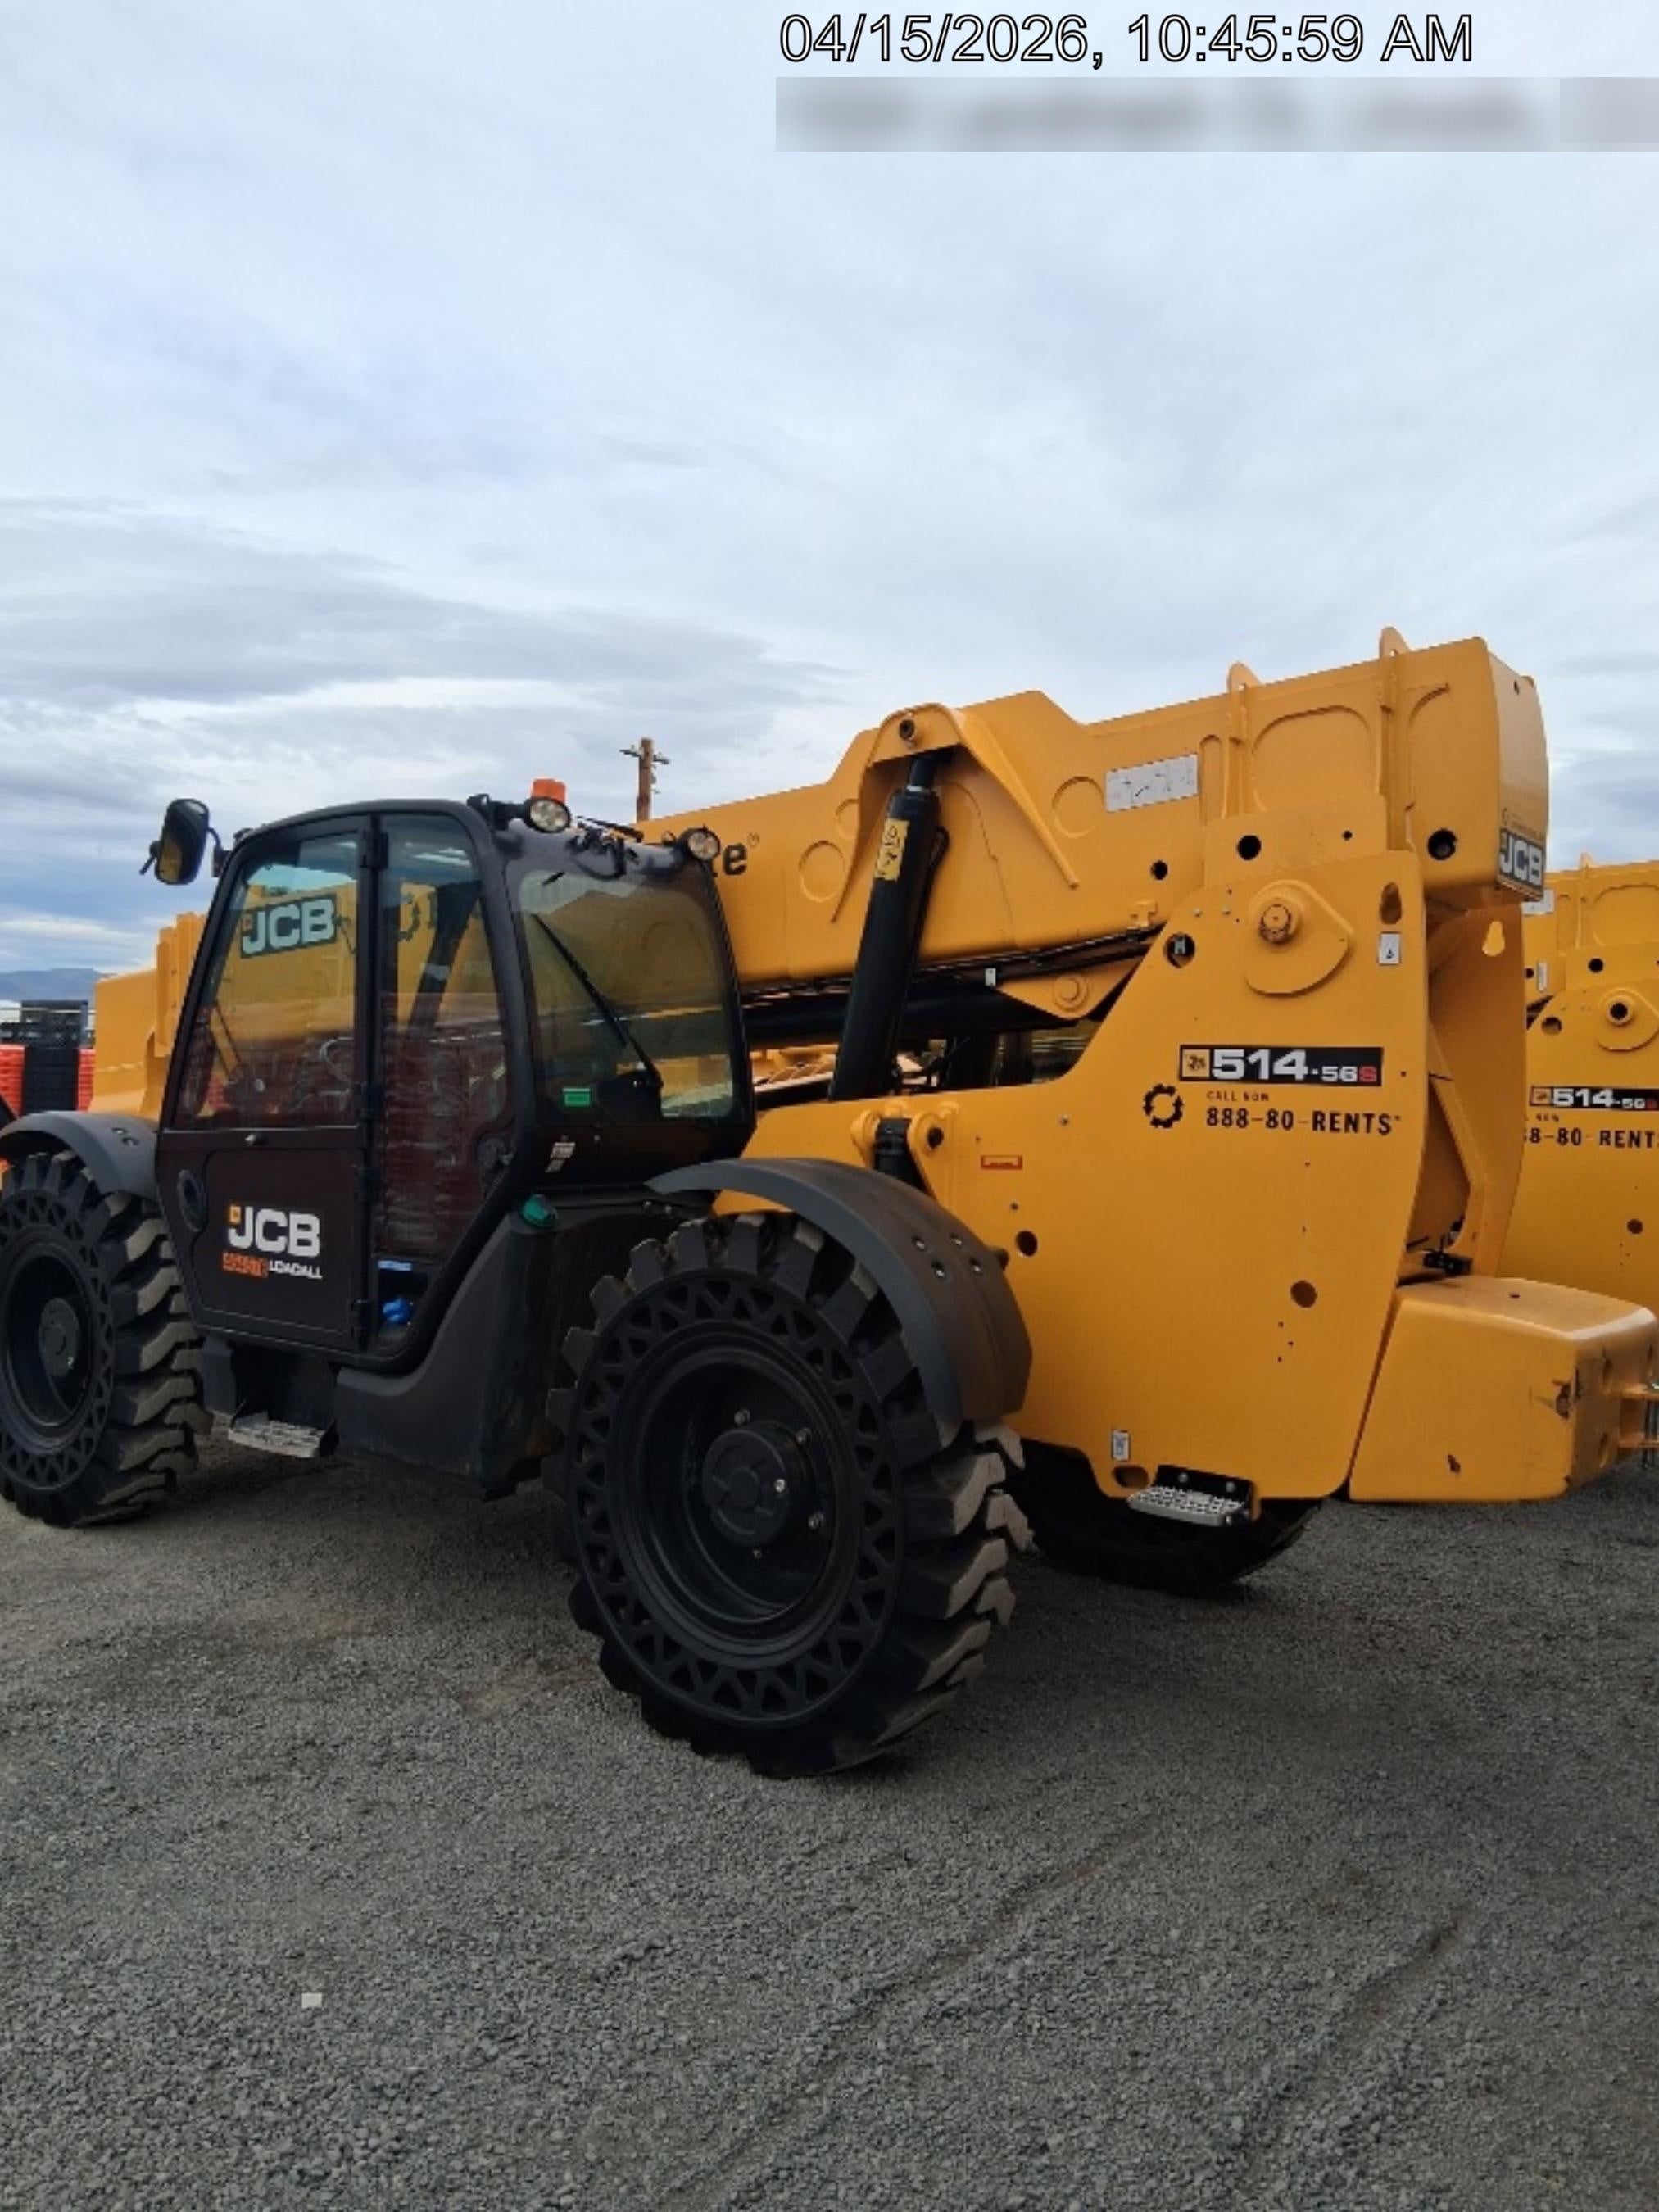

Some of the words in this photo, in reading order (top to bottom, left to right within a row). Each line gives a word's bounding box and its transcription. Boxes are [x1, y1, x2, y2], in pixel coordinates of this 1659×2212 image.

[1499, 833, 1543, 886] JCB
[243, 898, 335, 954] JCB
[228, 1206, 320, 1258] JCB
